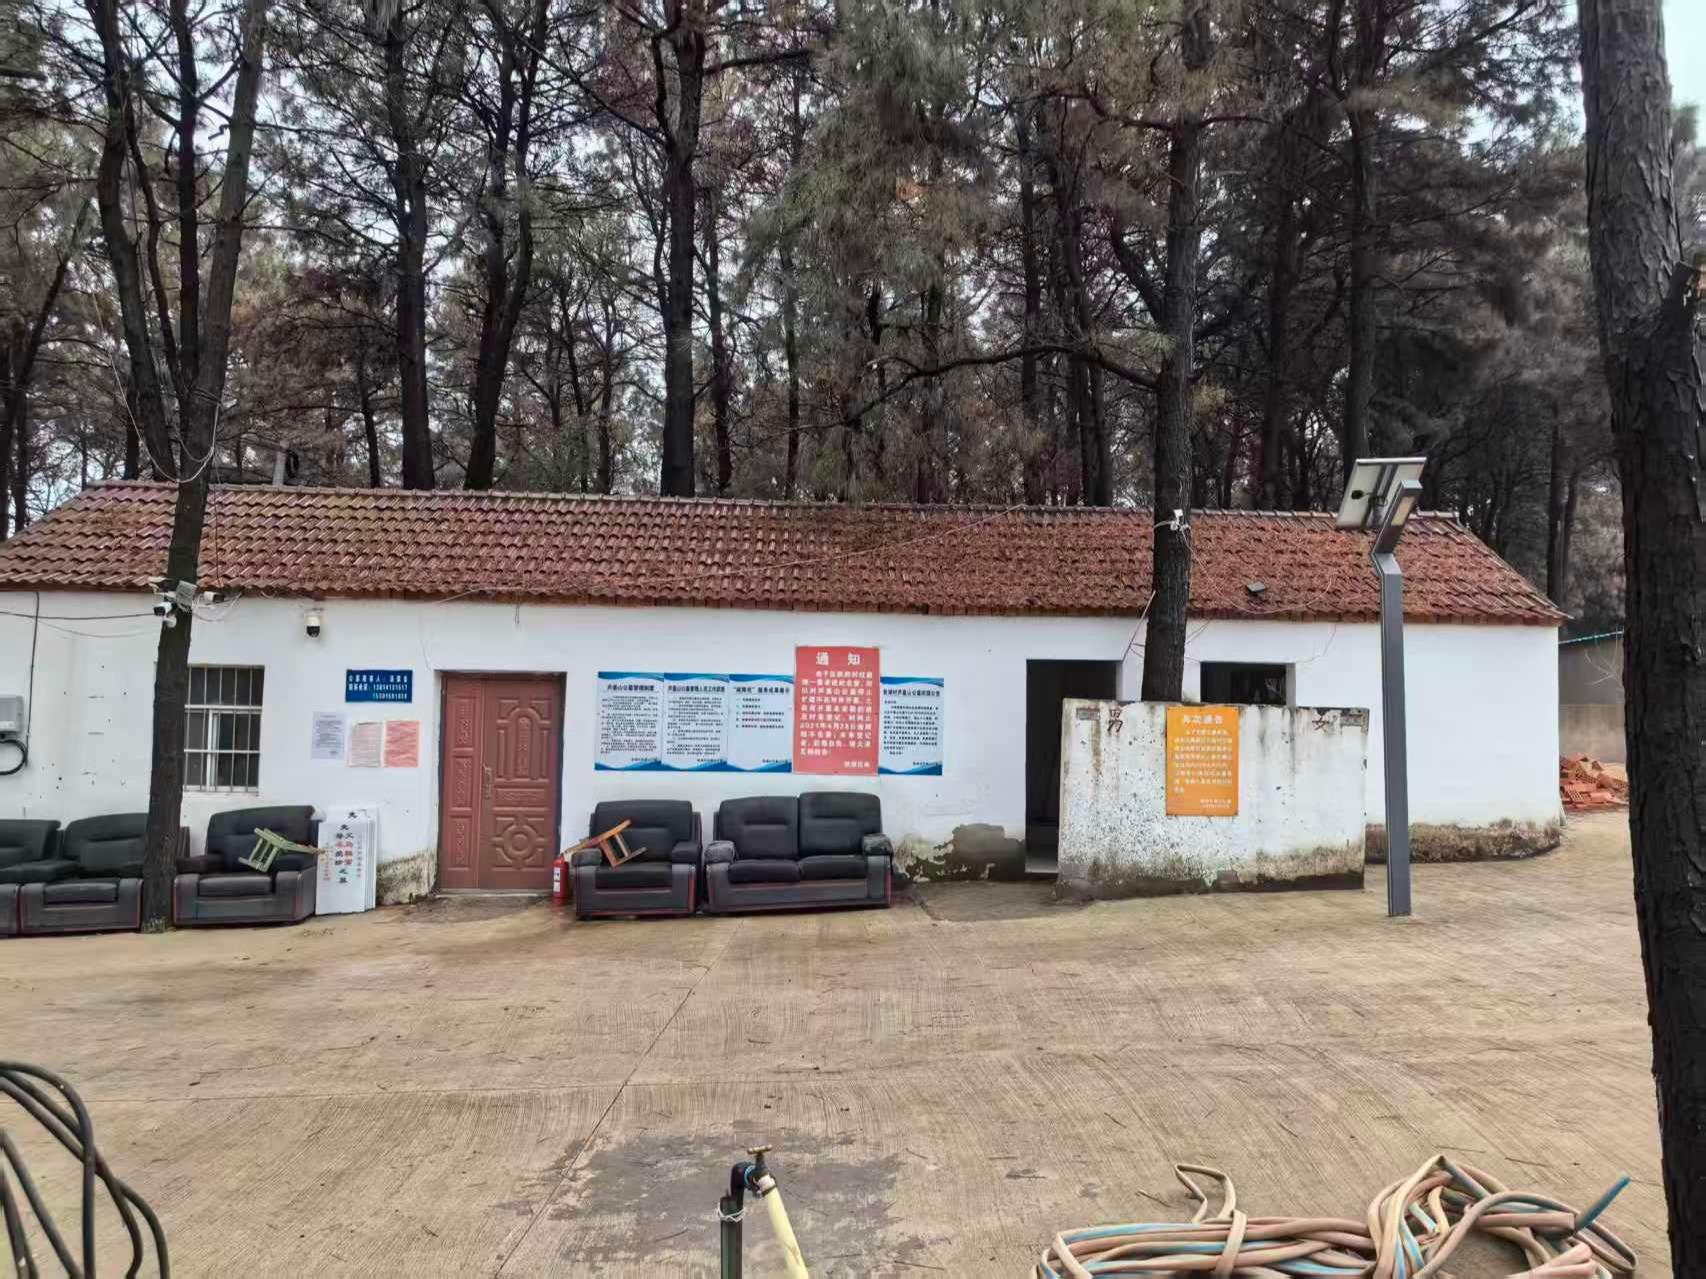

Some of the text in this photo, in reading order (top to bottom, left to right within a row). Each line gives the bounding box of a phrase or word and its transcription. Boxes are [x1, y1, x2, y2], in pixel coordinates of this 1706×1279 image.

[816, 652, 861, 666] 通知
[1107, 709, 1123, 733] 男
[1311, 716, 1330, 731] 女
